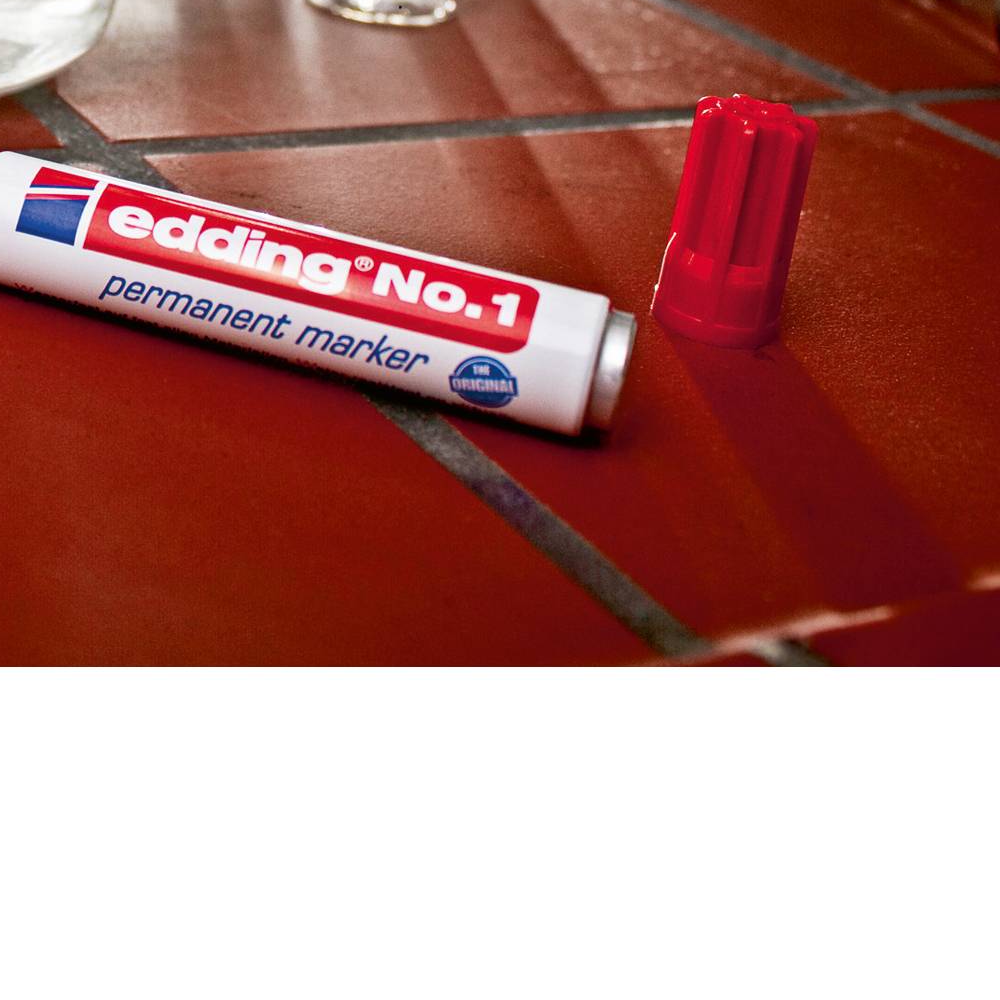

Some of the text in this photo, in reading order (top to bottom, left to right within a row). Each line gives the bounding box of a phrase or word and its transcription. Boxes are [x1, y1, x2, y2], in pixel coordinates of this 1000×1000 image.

[97, 274, 292, 340] permanent
[294, 325, 430, 374] marker
[371, 261, 521, 328] No.1
[452, 377, 516, 395] ORIGINAL
